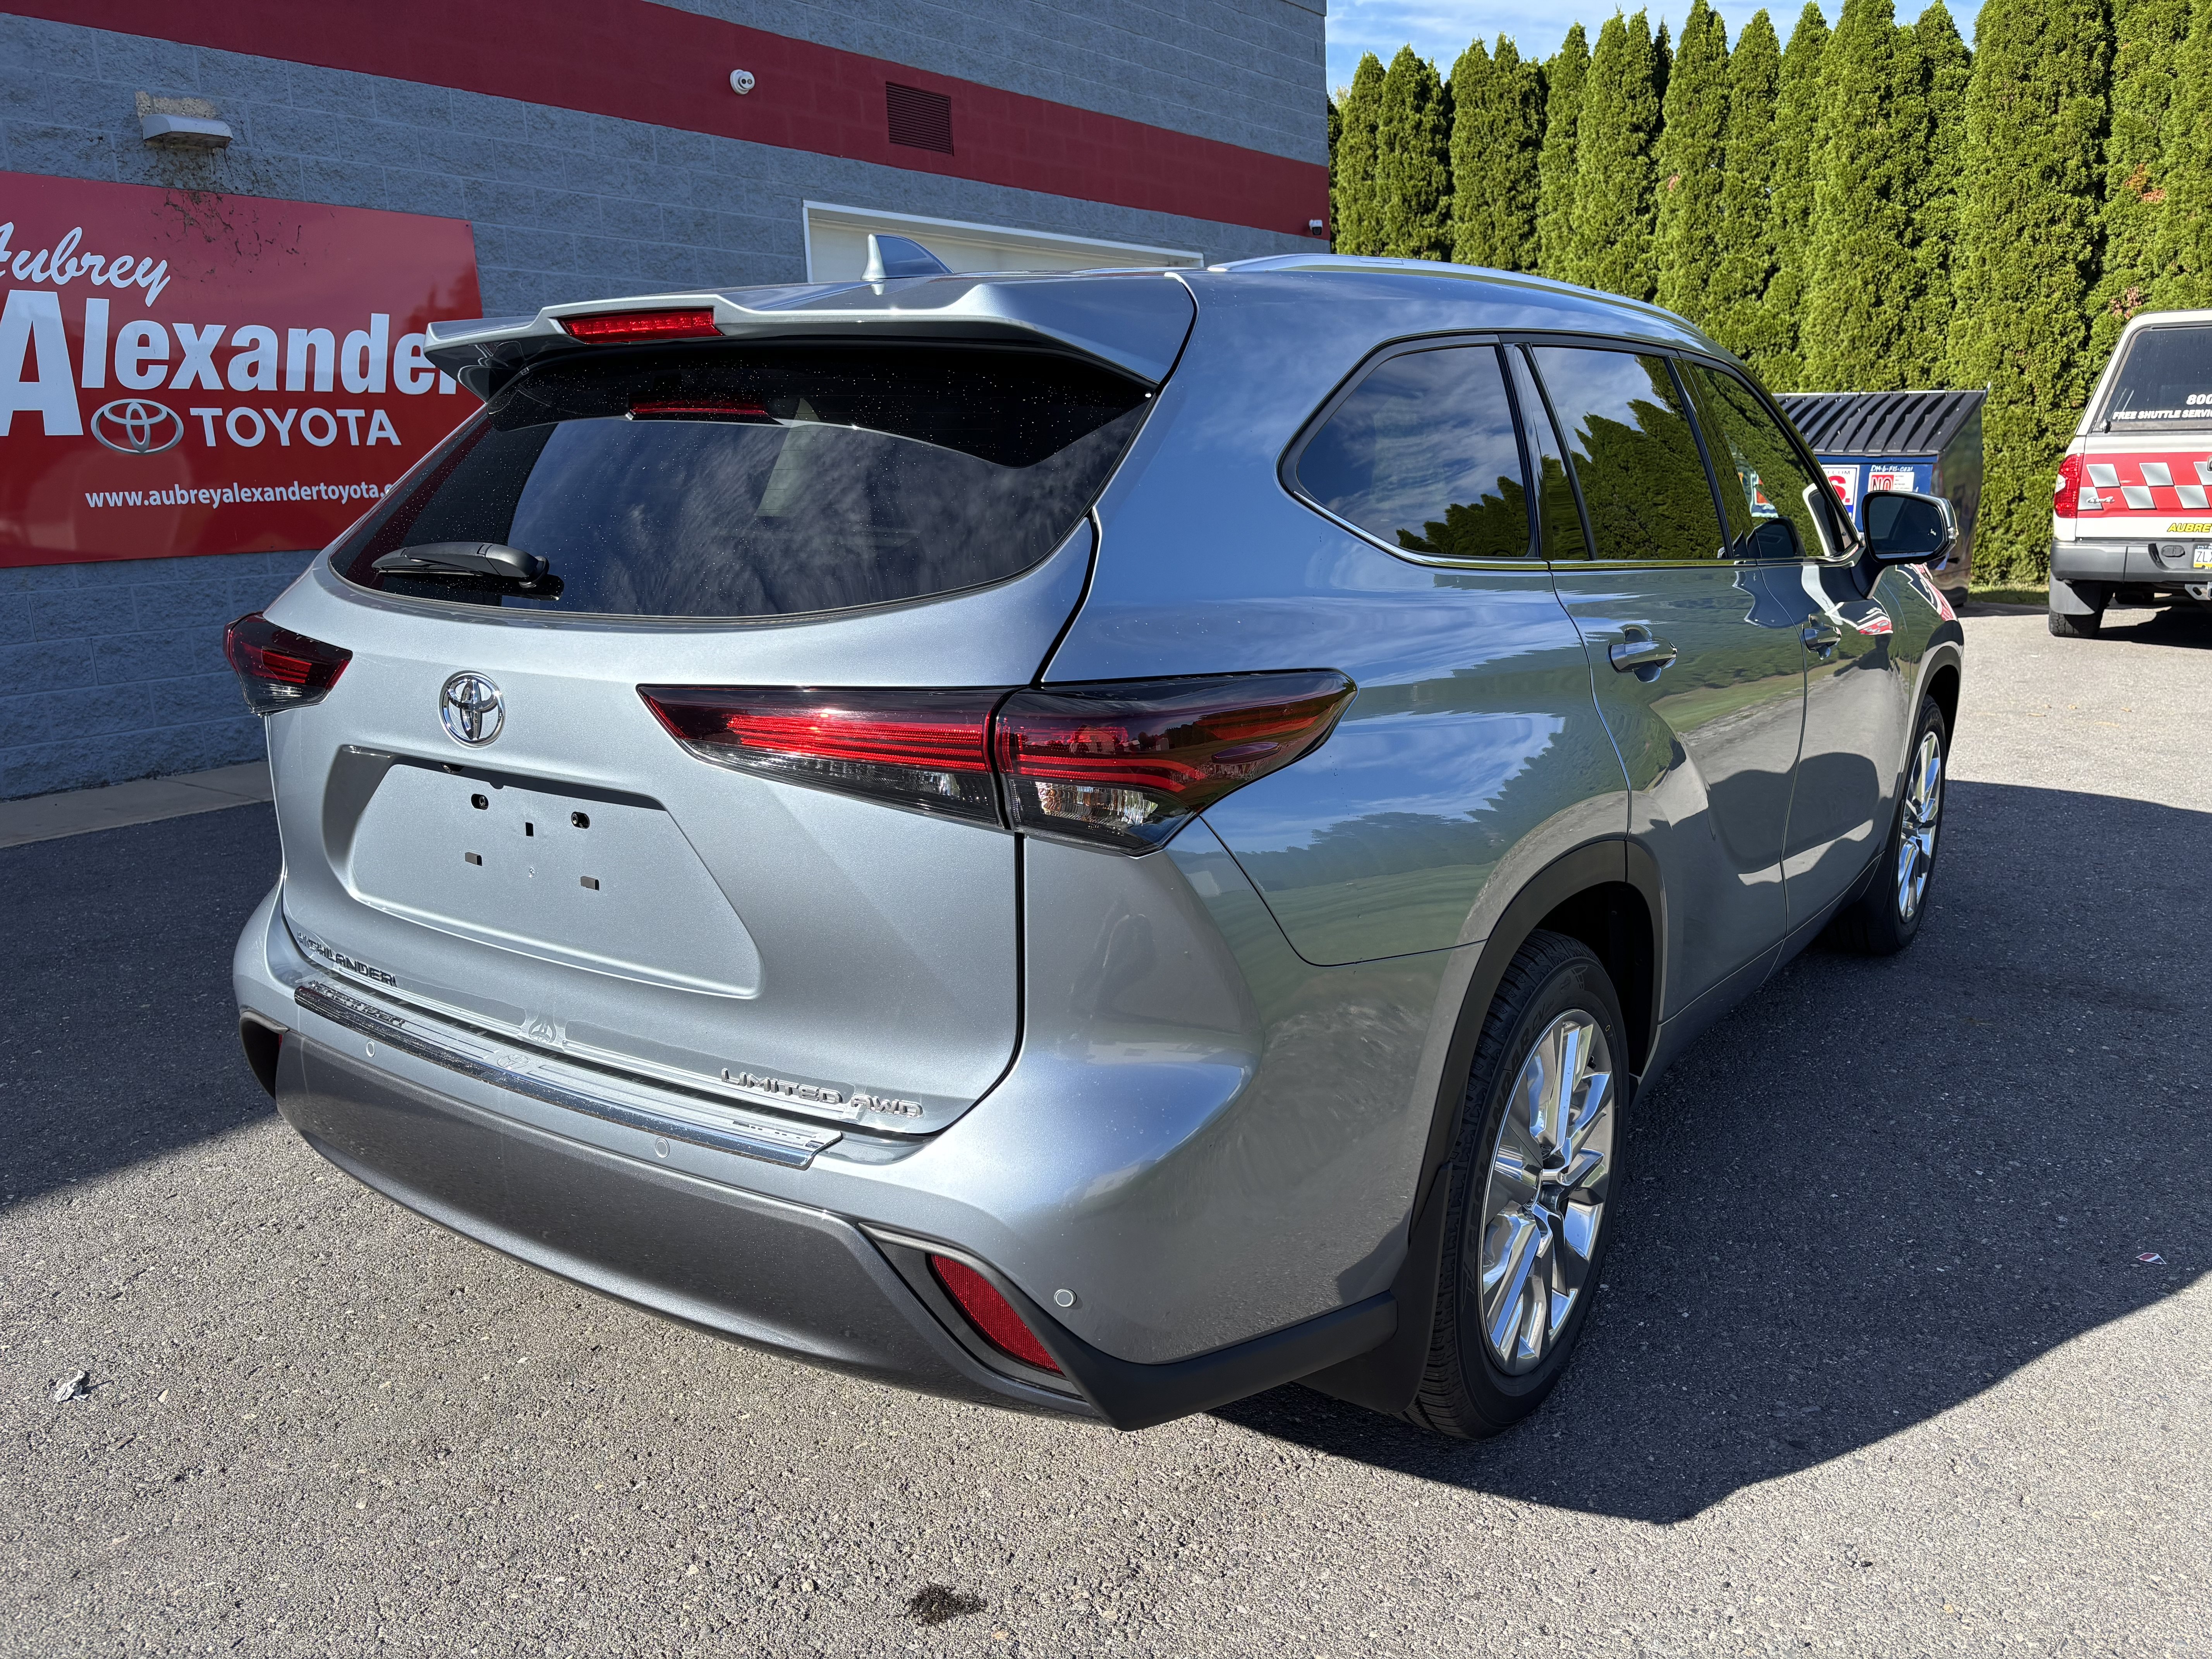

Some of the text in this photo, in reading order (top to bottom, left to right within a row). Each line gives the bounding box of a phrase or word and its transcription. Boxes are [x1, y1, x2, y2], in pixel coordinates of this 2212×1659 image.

[190, 407, 402, 447] TOYOTA
[2112, 409, 2212, 420] FREE SHUTTLE SERVI
[2167, 523, 2212, 532] AUBRE
[297, 931, 397, 988] HIGHLANDER
[721, 1068, 924, 1118] LIMITED AWD
